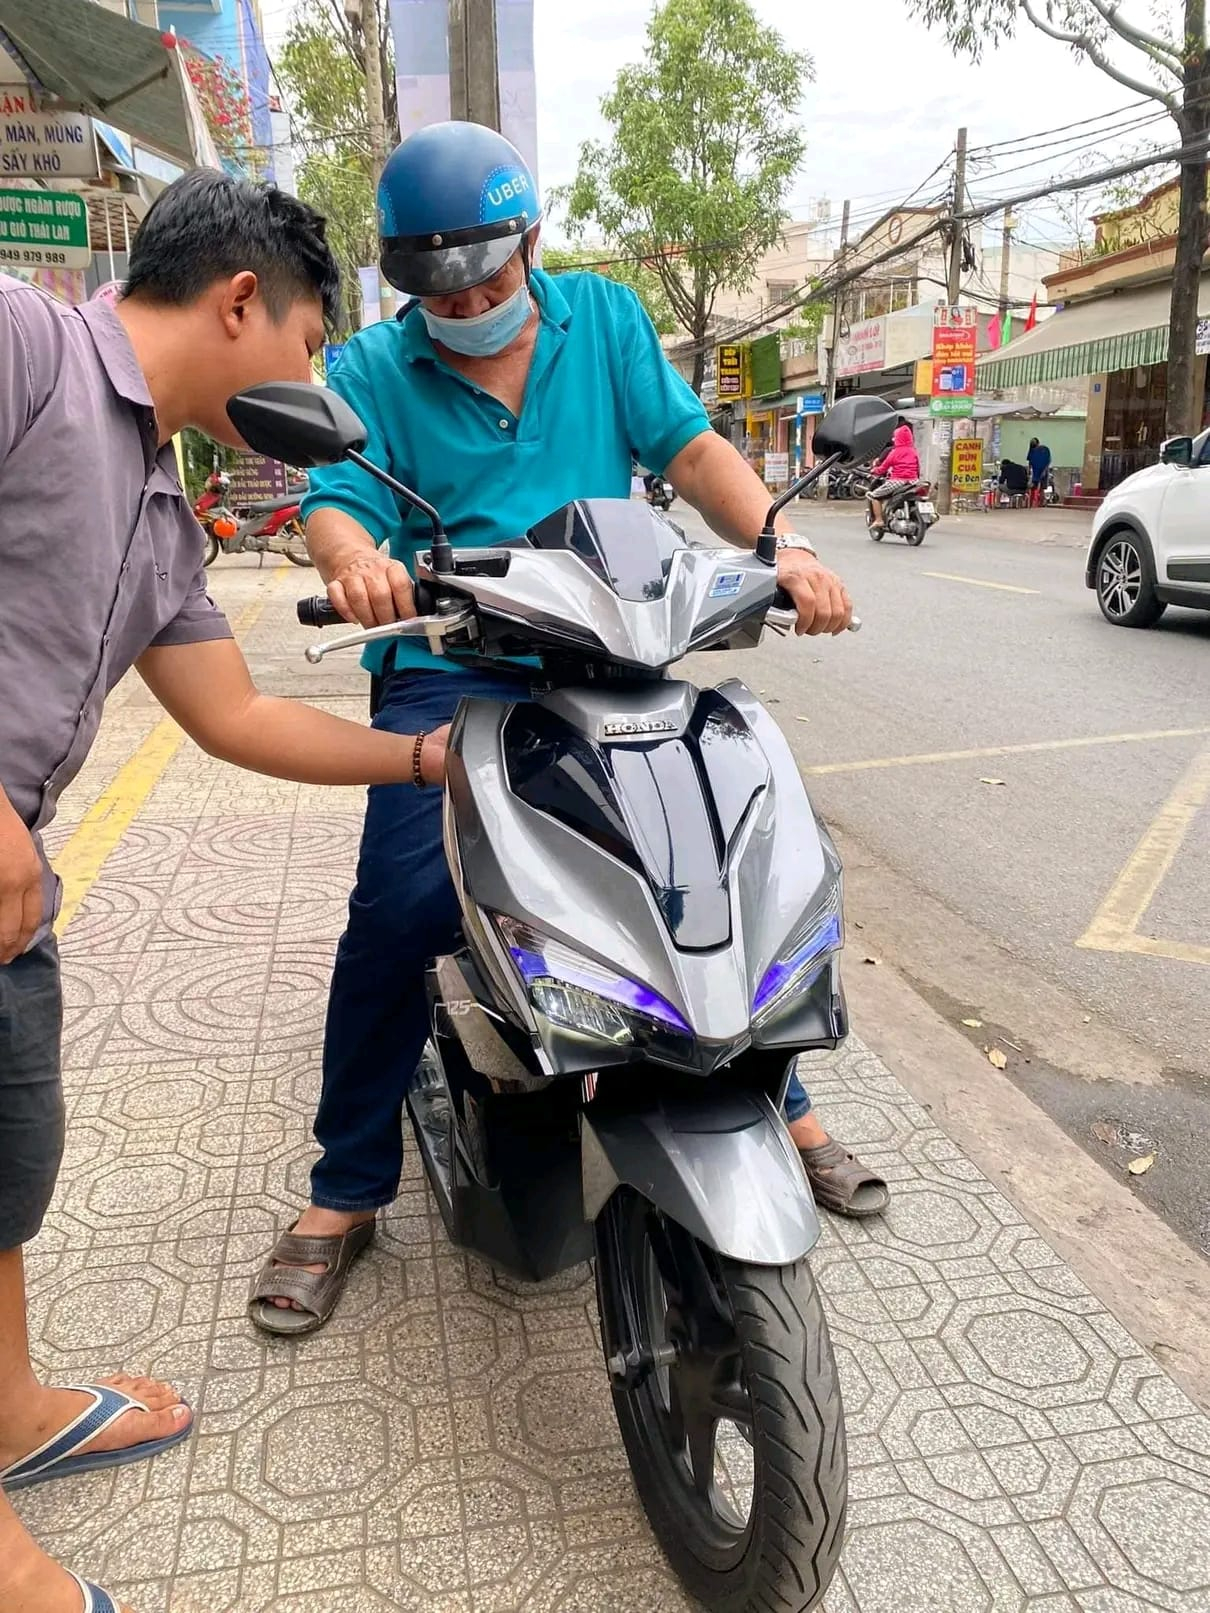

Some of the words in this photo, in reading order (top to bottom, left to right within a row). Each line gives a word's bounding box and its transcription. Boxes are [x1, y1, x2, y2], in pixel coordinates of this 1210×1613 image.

[5, 120, 41, 145] MÀN,
[43, 120, 83, 143] MÙNG
[2, 148, 27, 171] SẤY
[33, 149, 61, 171] KHÔ
[487, 175, 529, 206] UBER
[55, 199, 81, 220] RƯỢU
[51, 224, 70, 240] LAN
[23, 250, 42, 263] 979
[45, 251, 65, 264] 989
[956, 442, 981, 451] CANH
[958, 465, 977, 473] CUA
[604, 719, 679, 736] HONDA
[446, 999, 471, 1015] 125
